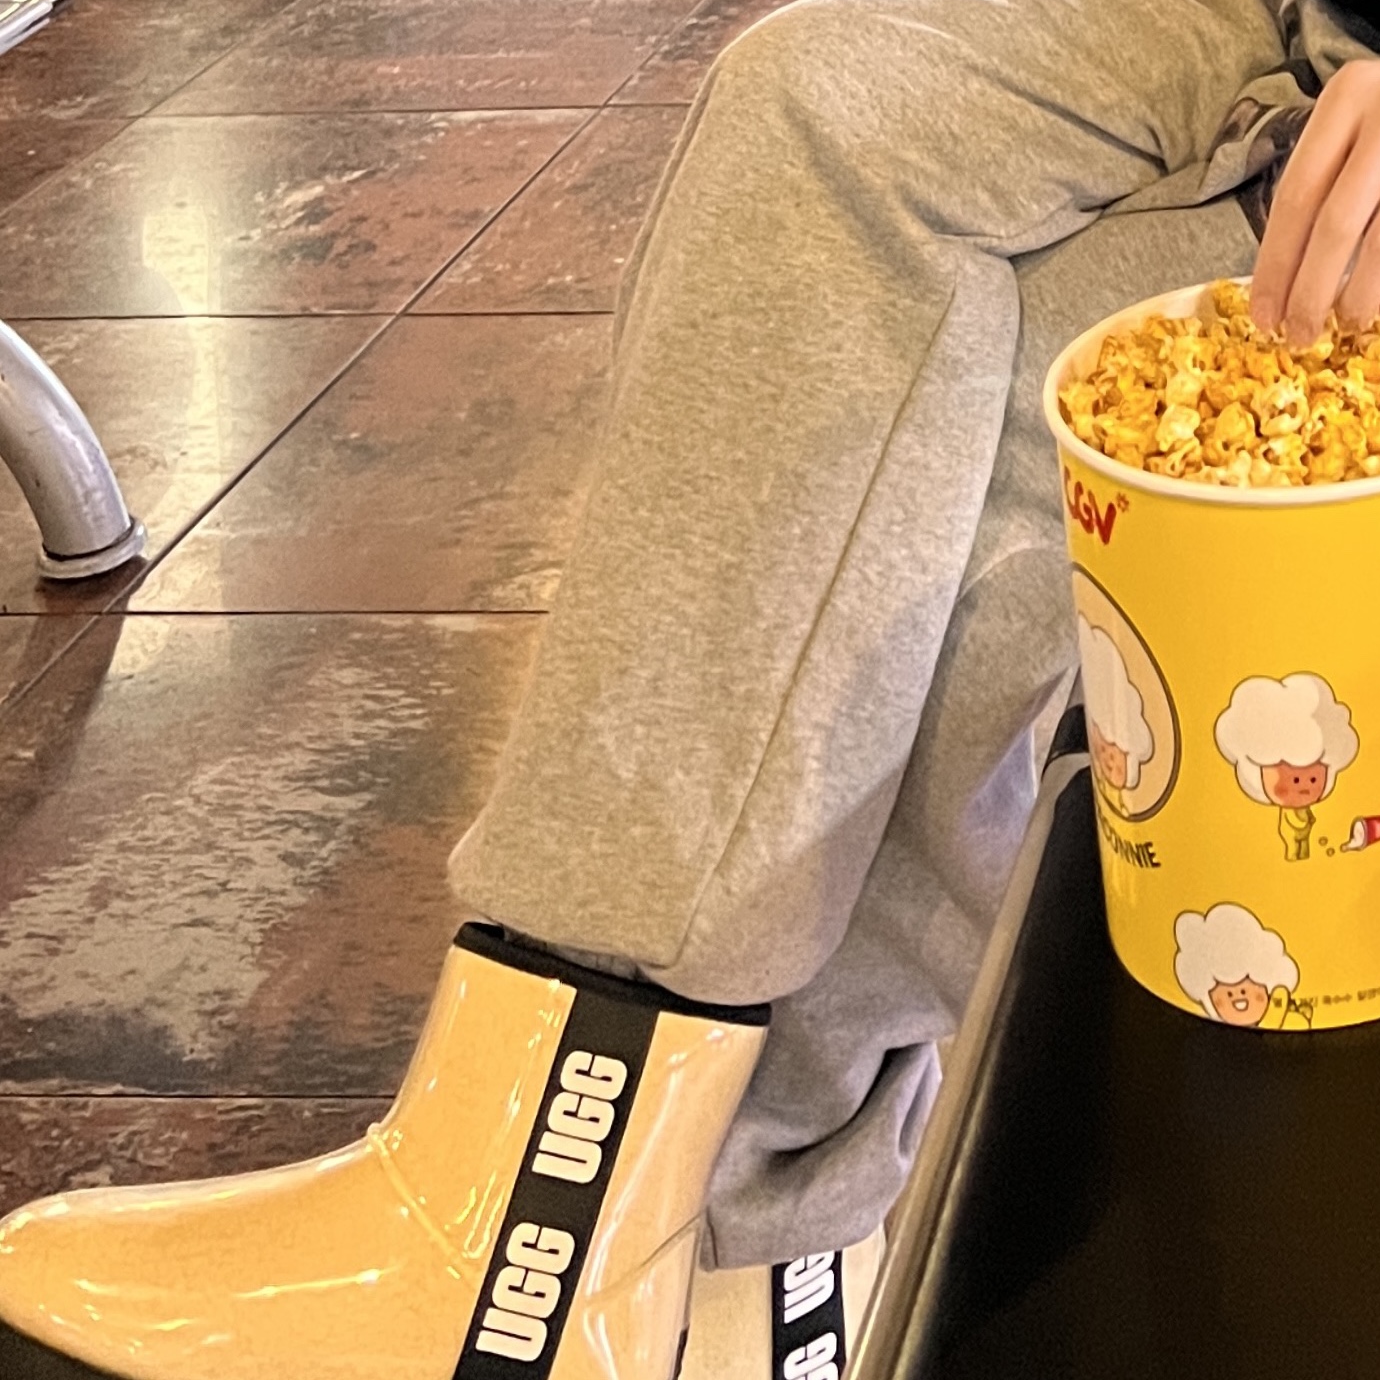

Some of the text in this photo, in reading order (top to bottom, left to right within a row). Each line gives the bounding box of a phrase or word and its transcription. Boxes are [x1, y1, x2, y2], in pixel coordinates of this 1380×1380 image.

[531, 1050, 628, 1185] UGG
[475, 1222, 576, 1362] UGG
[783, 1250, 836, 1324] UG
